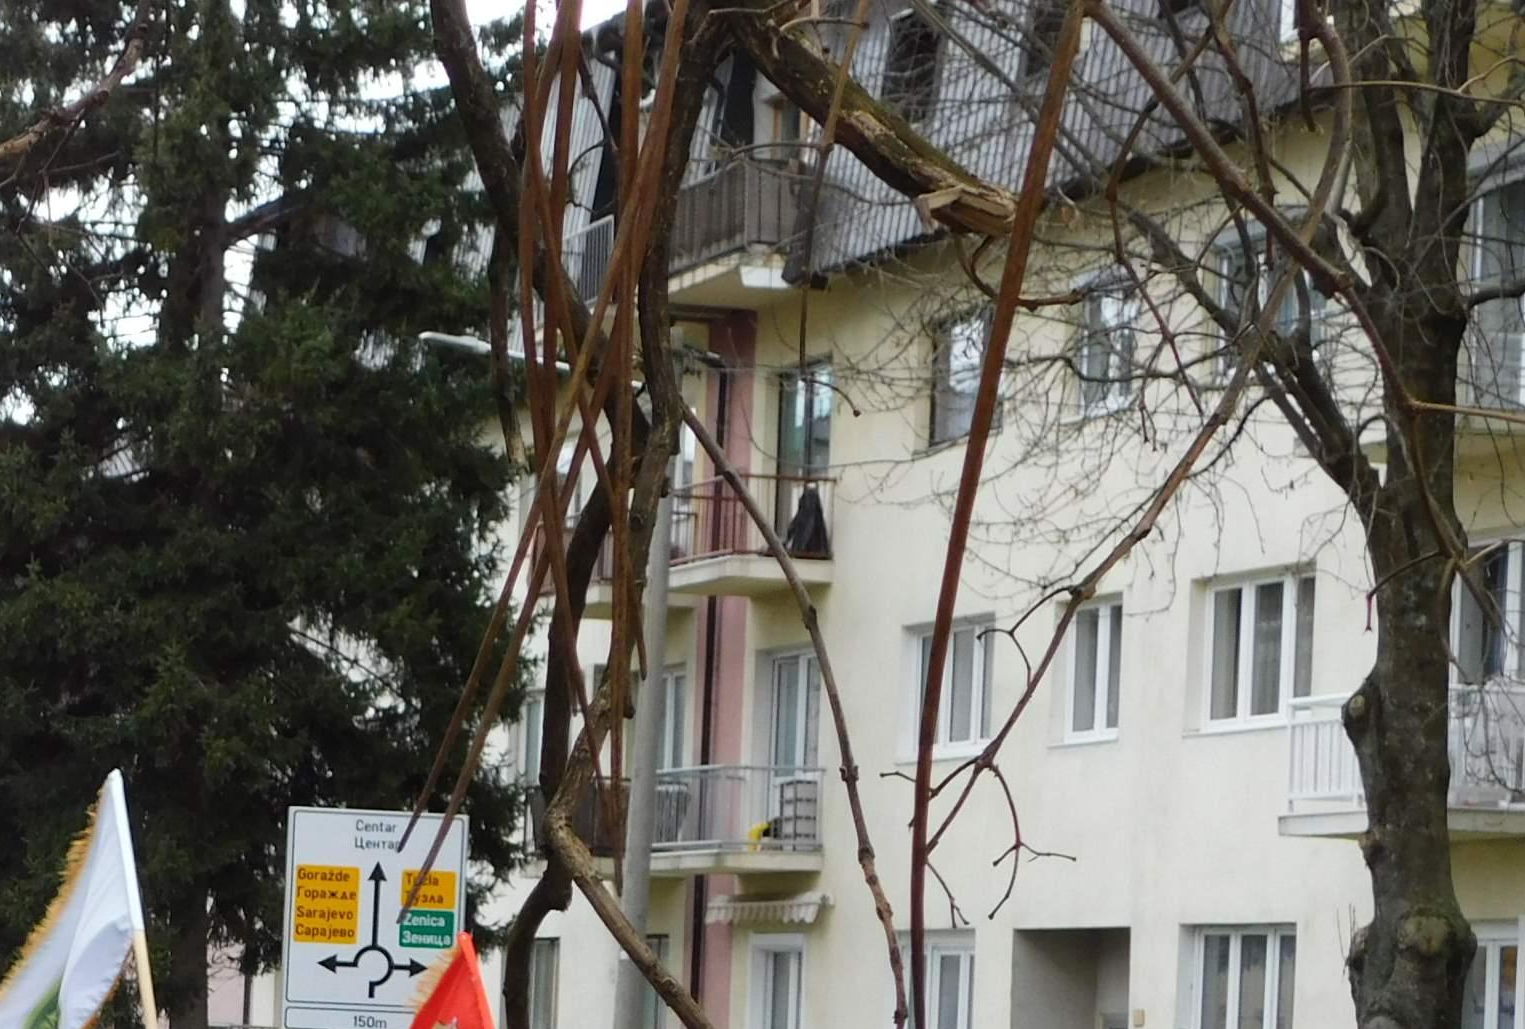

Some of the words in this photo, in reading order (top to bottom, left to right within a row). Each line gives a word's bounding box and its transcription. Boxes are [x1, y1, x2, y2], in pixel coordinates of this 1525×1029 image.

[356, 819, 397, 832] Centar
[298, 868, 351, 882] Goražde
[297, 886, 357, 901] Горажде
[297, 906, 354, 922] Sarajevo
[403, 912, 446, 927] Zenica
[402, 930, 452, 947] Зеница
[354, 1016, 388, 1028] 150m
